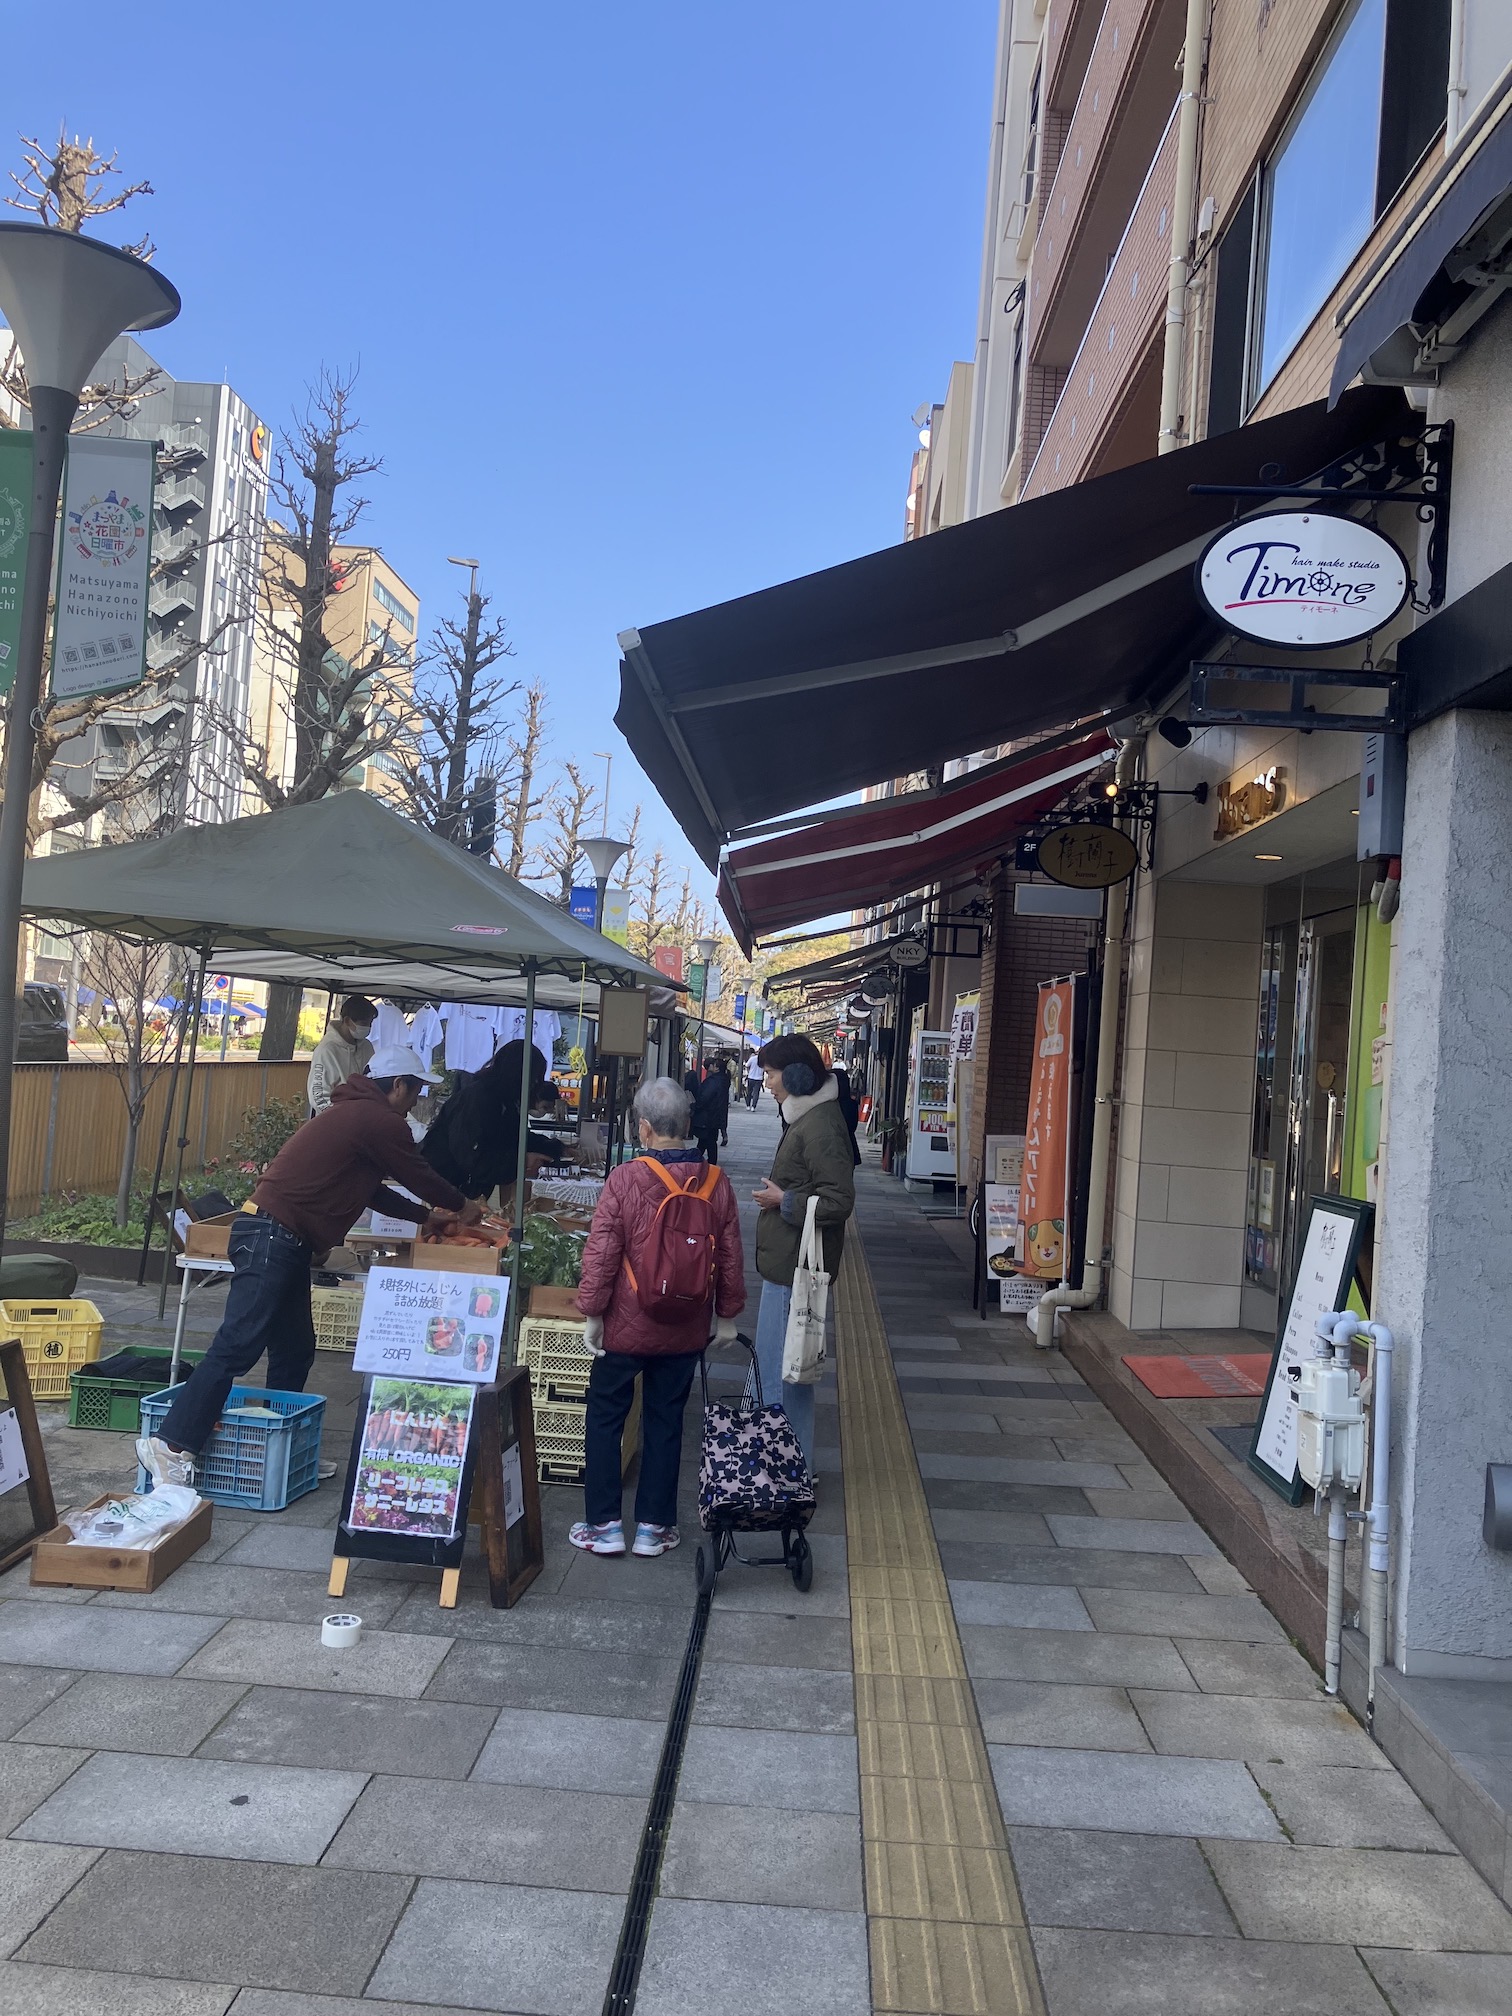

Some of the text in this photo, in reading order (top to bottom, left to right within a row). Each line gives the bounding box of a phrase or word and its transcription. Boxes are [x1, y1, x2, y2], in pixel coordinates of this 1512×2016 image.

[92, 511, 125, 525] まつやま
[95, 524, 121, 538] 花園
[91, 537, 125, 552] 日曜市
[1291, 556, 1380, 569] hair make studio
[69, 573, 139, 590] Matsuyama
[68, 589, 138, 606] Hanazono
[66, 604, 138, 622] Nichiyoichi
[1300, 604, 1339, 614] ティモーネ
[77, 682, 96, 690] design
[1023, 843, 1037, 852] 2F
[896, 947, 920, 956] NKY
[314, 1063, 324, 1080] BOLD
[928, 1113, 943, 1125] 100
[1315, 1271, 1324, 1283] Menu
[379, 1278, 462, 1296] 規格外にんじん
[394, 1293, 445, 1311] 詰め放題
[382, 1347, 412, 1361] 250円
[390, 1410, 447, 1430] にんじん
[365, 1447, 389, 1461] 有機
[393, 1450, 461, 1468] ORGANIC
[367, 1471, 449, 1494] リーフレタス
[365, 1493, 447, 1516] サニーレタス
